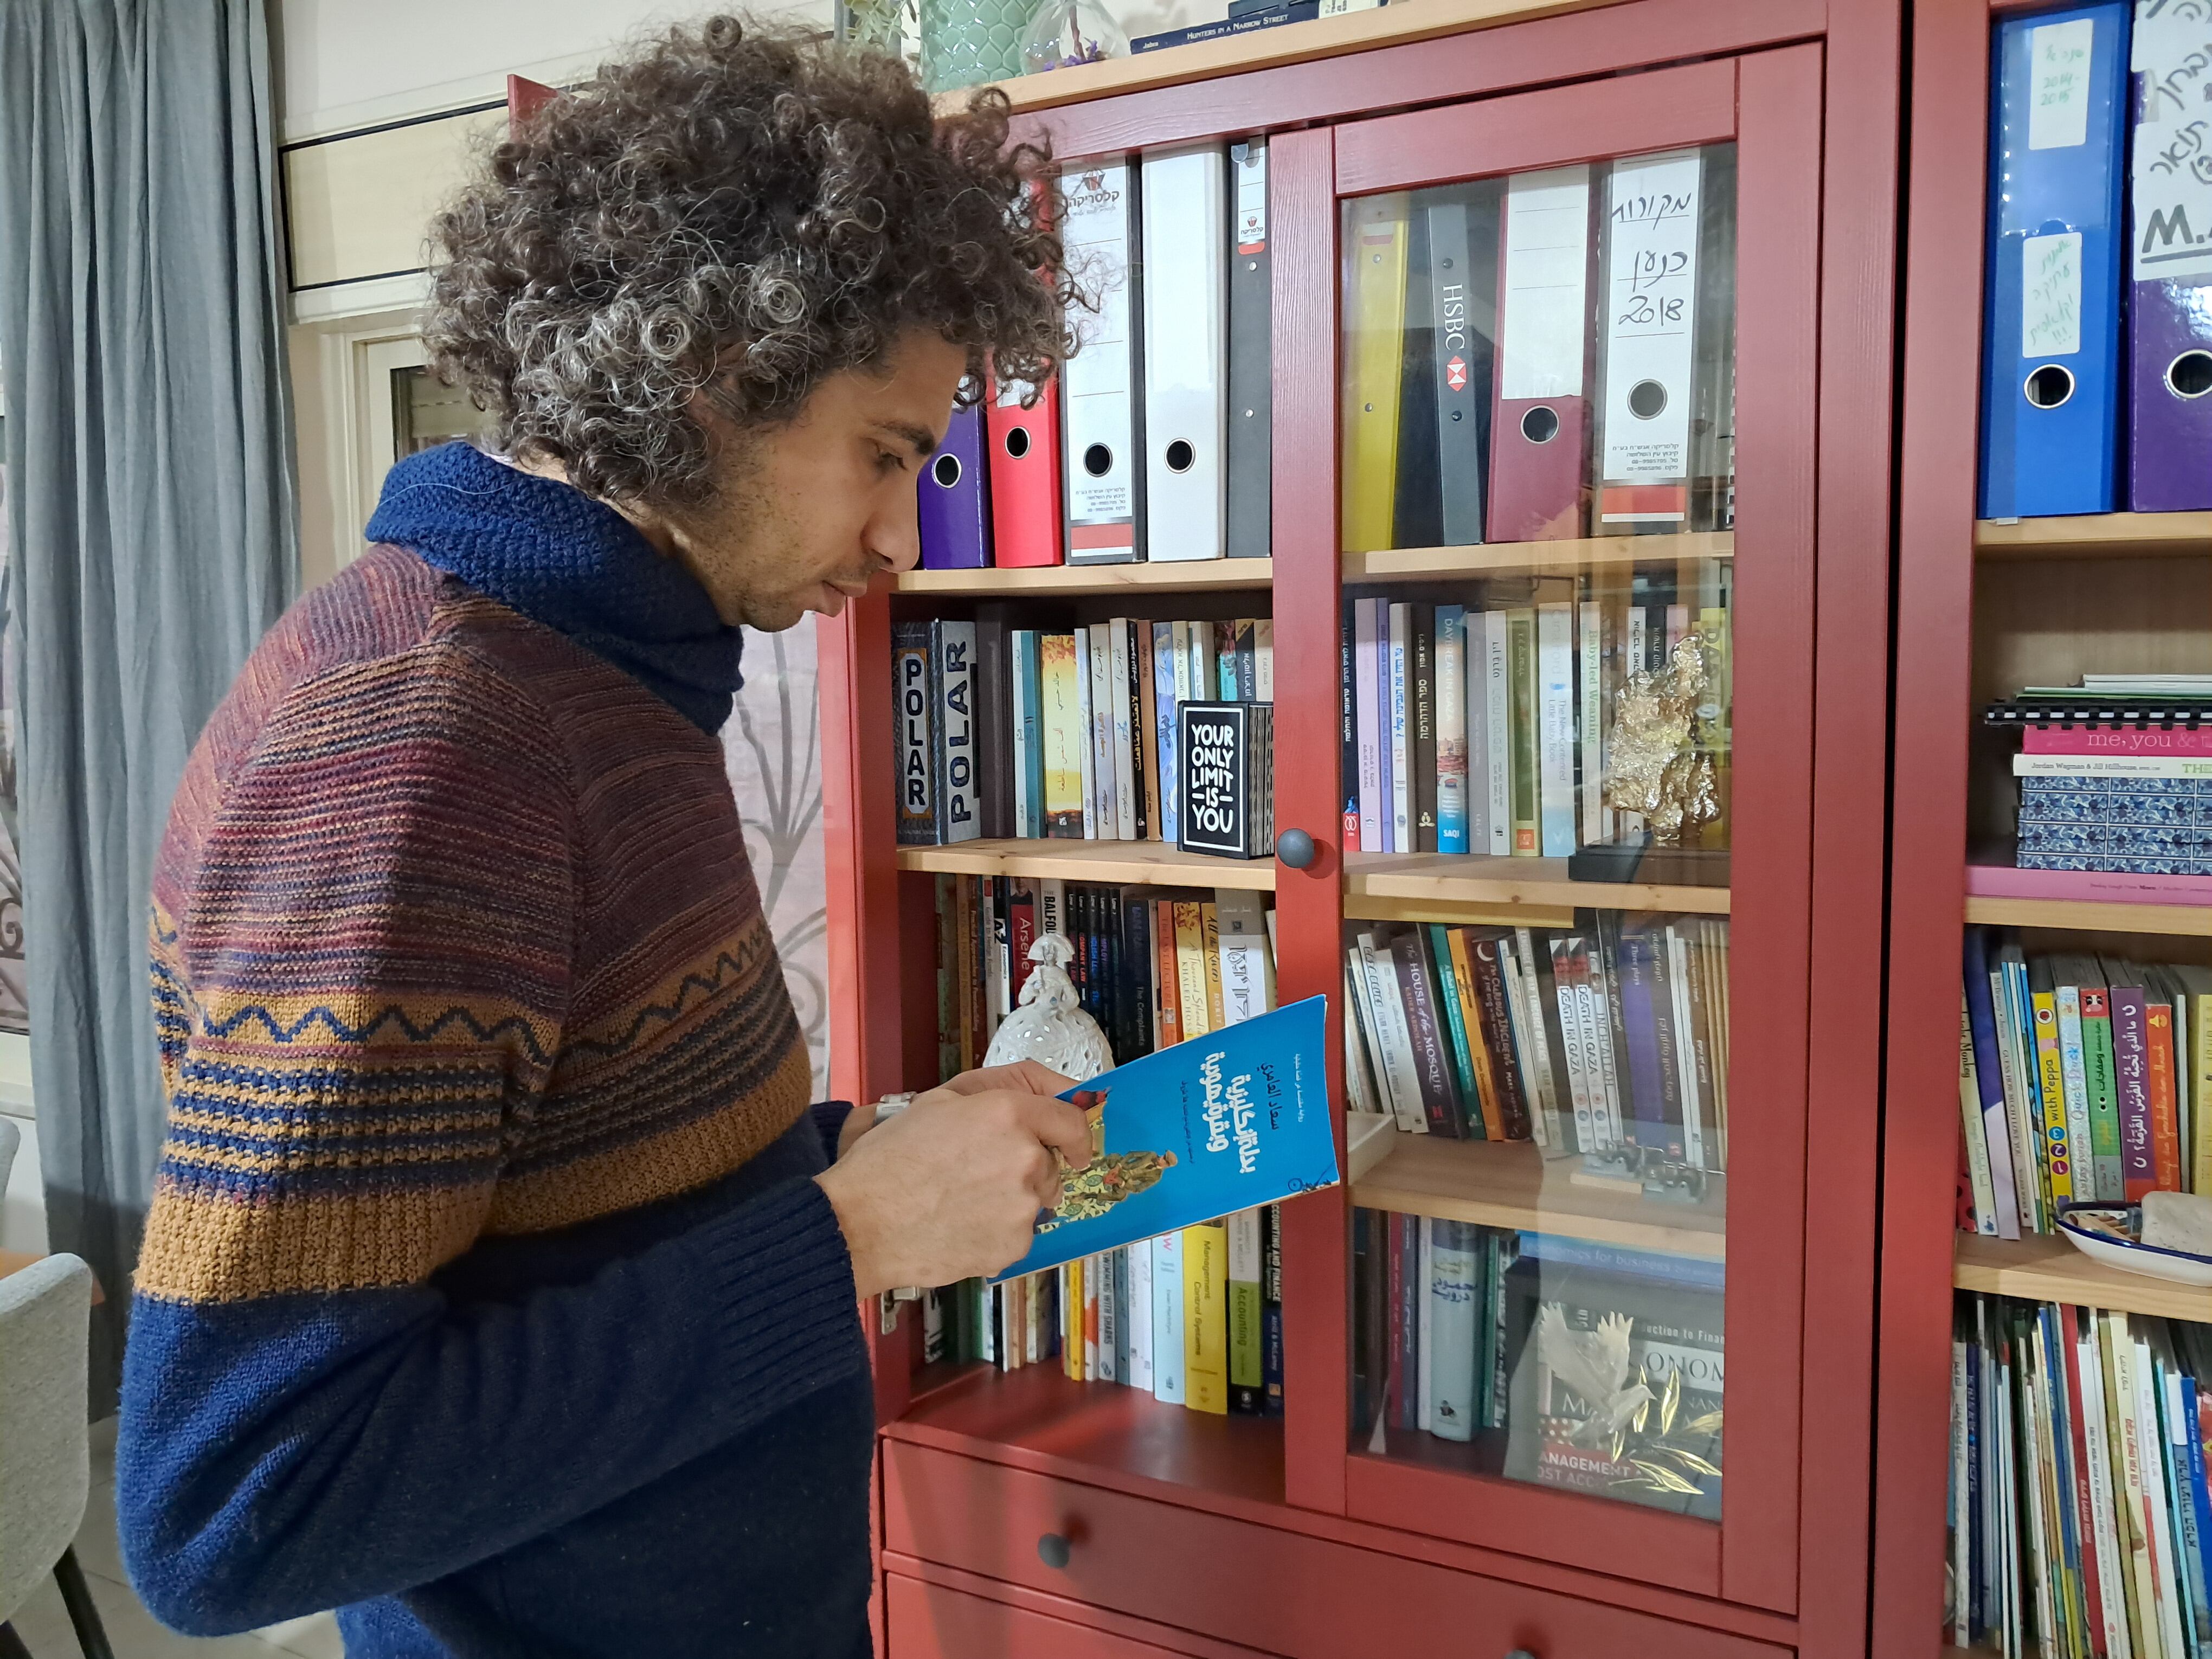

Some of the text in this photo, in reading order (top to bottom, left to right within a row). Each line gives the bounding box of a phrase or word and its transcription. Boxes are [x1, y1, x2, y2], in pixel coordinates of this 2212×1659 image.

[1233, 20, 1261, 31] NARROW
[1263, 14, 1289, 26] STREET
[1069, 190, 1120, 208] קלסריקה
[1611, 191, 1692, 230] מקורות
[1443, 282, 1465, 350] HSBC
[1618, 295, 1684, 326] 2018
[1242, 653, 1252, 674] אליסון
[1492, 641, 1501, 653] דין
[1396, 676, 1404, 687] את
[1444, 618, 1455, 722] DAYBREAK IN GAZA
[1585, 629, 1598, 744] Baby-led Weaning
[1396, 689, 1404, 715] הגבינה
[1418, 679, 1429, 740] ספר הדהרמה
[906, 658, 926, 806] POLAR
[947, 640, 972, 824] POLAR
[1191, 724, 1234, 747] YOUR
[1393, 717, 1404, 731] שלי
[1546, 699, 1557, 763] Little Baby Book
[1558, 700, 1567, 781] The New Contented
[2087, 732, 2195, 750] me, you &
[1192, 747, 1234, 769] ONLY
[1192, 768, 1234, 789] LIMIT
[1193, 804, 1234, 834] YOU
[1443, 829, 1460, 838] SAQI
[994, 918, 1006, 944] A-Z
[1207, 916, 1219, 932] All
[1019, 917, 1032, 970] Arsene
[1181, 961, 1190, 1002] KHALED
[1189, 941, 1201, 993] A Thousand
[1209, 949, 1221, 983] Rivers
[1630, 946, 1642, 986] Three plays
[1444, 970, 1455, 998] Rebel in
[1136, 1002, 1145, 1046] Complaints
[1528, 994, 1543, 1028] LANGUAGE
[2125, 1020, 2137, 1030] ما
[1409, 962, 1426, 1006] HOUSE
[1420, 1035, 1443, 1095] MOSQUE
[1534, 1029, 1545, 1039] OF
[1558, 986, 1583, 1075] DEATH IN GAZA
[1577, 985, 1600, 1075] DEATH IN GAZA
[2040, 1058, 2061, 1094] Peppa
[1199, 1051, 1230, 1153] وبقرة يهودية
[1256, 1062, 1283, 1131] سعاد العامري
[2001, 1049, 2011, 1073] GUESS
[2014, 1141, 2023, 1158] YOU
[2044, 1096, 2059, 1121] with
[1225, 1074, 1261, 1174] بدلة إنكليزية
[2052, 1128, 2060, 1139] 3
[2053, 1143, 2062, 1156] 2
[1201, 1240, 1211, 1300] Management
[1271, 1249, 1281, 1266] AND
[1595, 1250, 1670, 1273] for business
[1103, 1252, 1113, 1345] SWIMMING WITH SHARKS
[1272, 1268, 1281, 1302] FINANCE
[1237, 1287, 1248, 1346] Accounting
[1193, 1317, 1202, 1356] Systems
[1683, 1328, 1694, 1340] to
[2176, 1458, 2197, 1548] ארץ יצורי הפרא
